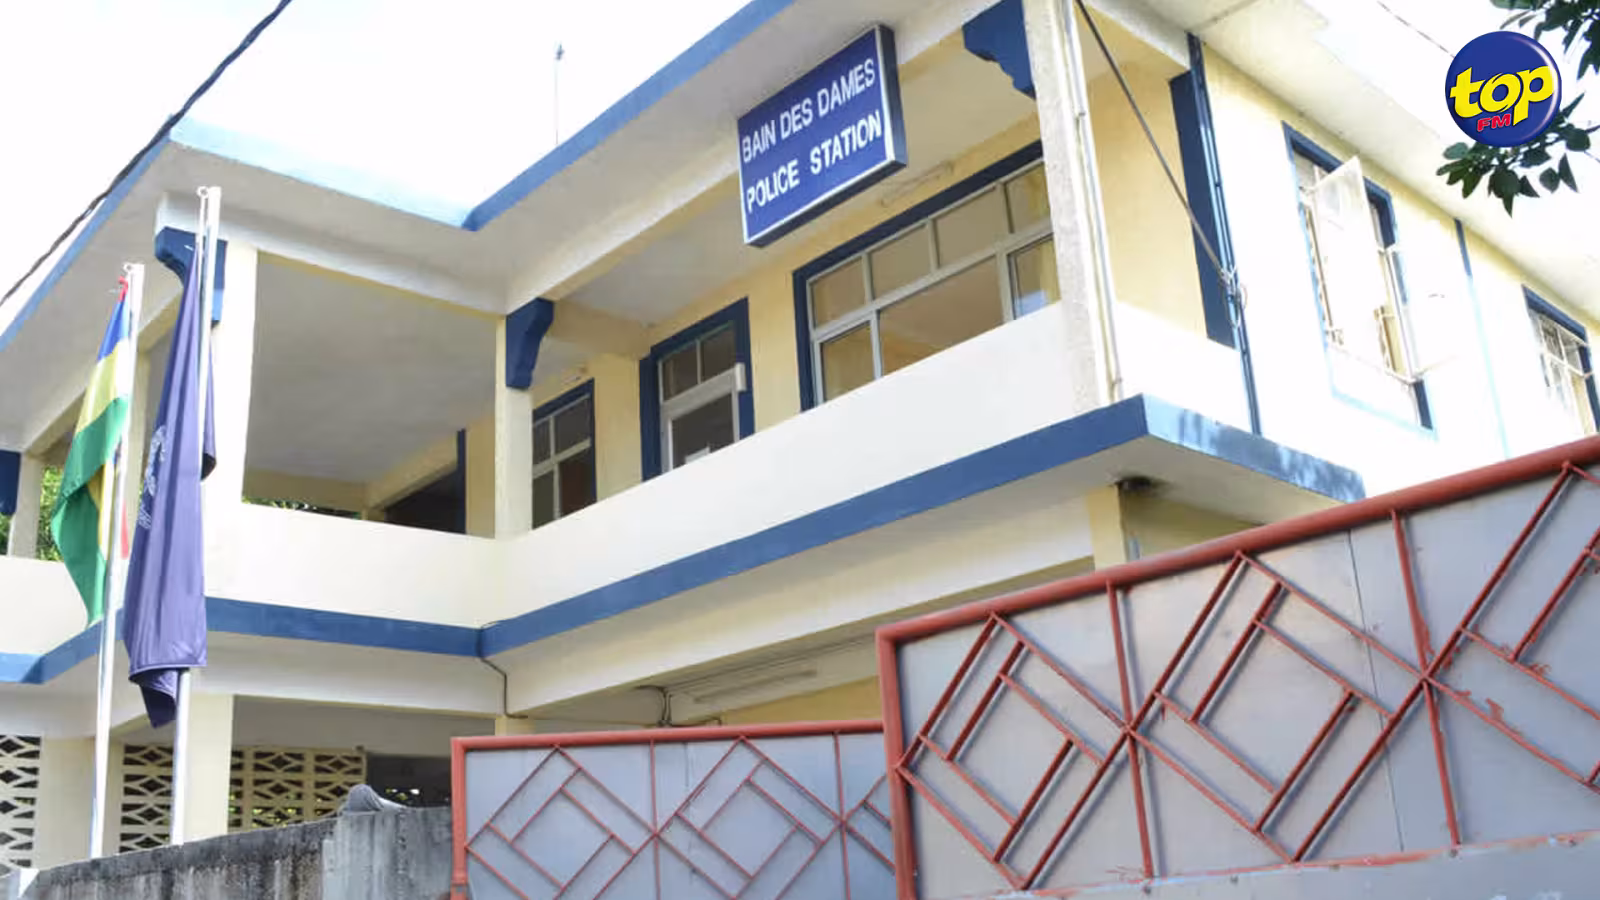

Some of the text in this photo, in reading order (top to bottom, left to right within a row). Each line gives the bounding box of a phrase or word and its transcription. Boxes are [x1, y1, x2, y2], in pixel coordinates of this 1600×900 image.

[743, 59, 875, 163] BAIN DES DAMES
[747, 110, 881, 213] POLICE STATION
